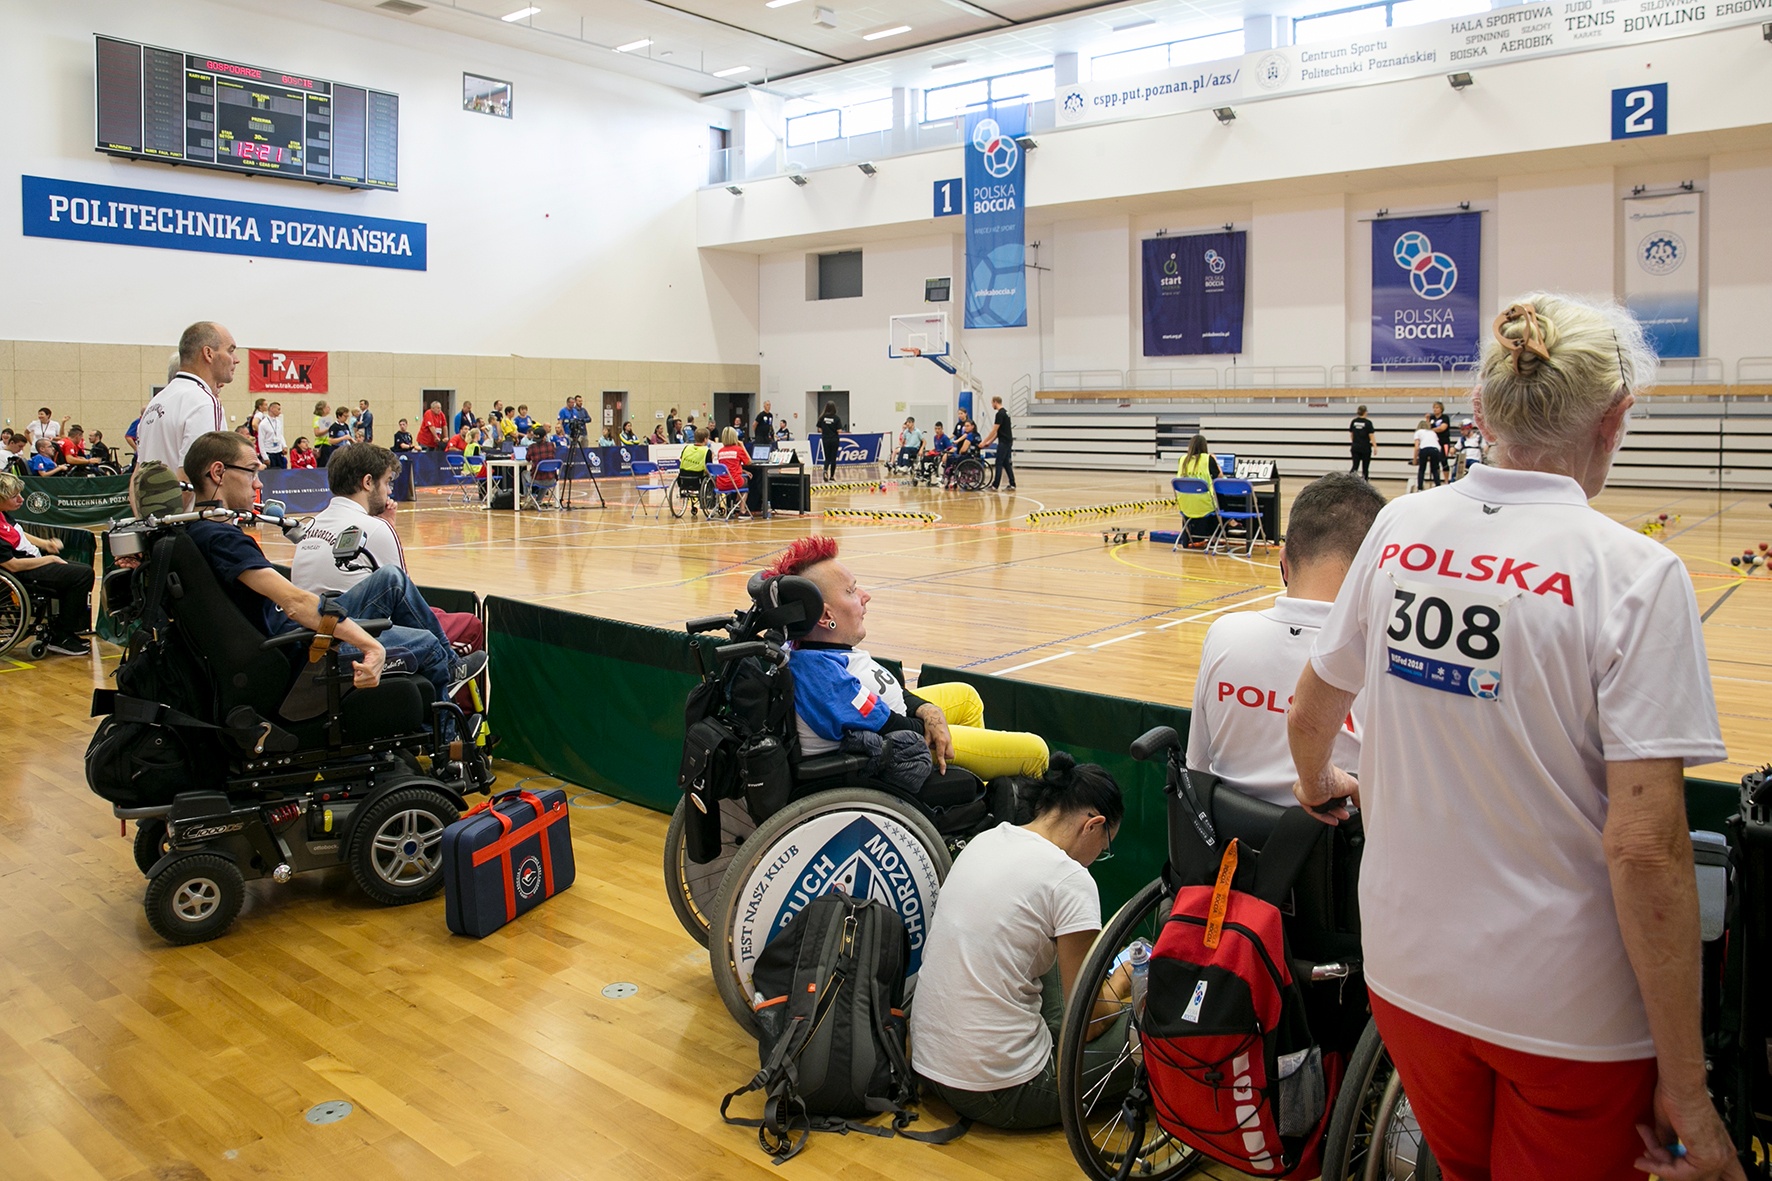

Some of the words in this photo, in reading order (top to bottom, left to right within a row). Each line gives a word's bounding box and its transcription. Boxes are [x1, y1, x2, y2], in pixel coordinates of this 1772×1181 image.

[1564, 0, 1592, 14] JUDO
[1451, 19, 1484, 34] HALA
[1486, 6, 1554, 28] SPORTOWA
[1565, 10, 1615, 31] TENIS
[1624, 6, 1705, 33] BOWLING
[1301, 48, 1347, 63] Centrum
[1350, 41, 1388, 56] Sportu
[1450, 46, 1488, 61] BOISKA
[1500, 34, 1554, 53] AEROBIK
[206, 60, 262, 79] GOSPODARZE
[1301, 61, 1363, 81] Politechniki
[1368, 49, 1437, 70] Poznańskiej
[1093, 68, 1241, 107] cspp.put.poznan.pl/azs/
[1625, 90, 1653, 134] 2
[237, 141, 282, 163] 12:21
[941, 182, 952, 213] 1
[973, 184, 1016, 200] POLSKA
[973, 198, 1016, 214] BOCCIA
[48, 194, 261, 242] POLITECHNIKA
[270, 219, 413, 256] POZNAŃSKA
[974, 287, 1016, 297] polskaboccia.pl
[1160, 276, 1182, 286] start
[1394, 308, 1455, 324] POLSKA
[1394, 324, 1455, 340] BOCCIA
[258, 352, 313, 384] TRAK
[265, 382, 313, 390] www.trak.com.pl
[57, 497, 109, 506] POLITECHNIKA
[1378, 542, 1575, 608] POLSKA
[1386, 588, 1501, 661] 308
[764, 844, 800, 882] KLUB
[744, 880, 771, 924] NASZ
[862, 833, 924, 951] CHORZÓW
[1213, 893, 1222, 913] BOCCIA
[741, 926, 756, 963] JEST
[1206, 922, 1215, 943] BOCCIA
